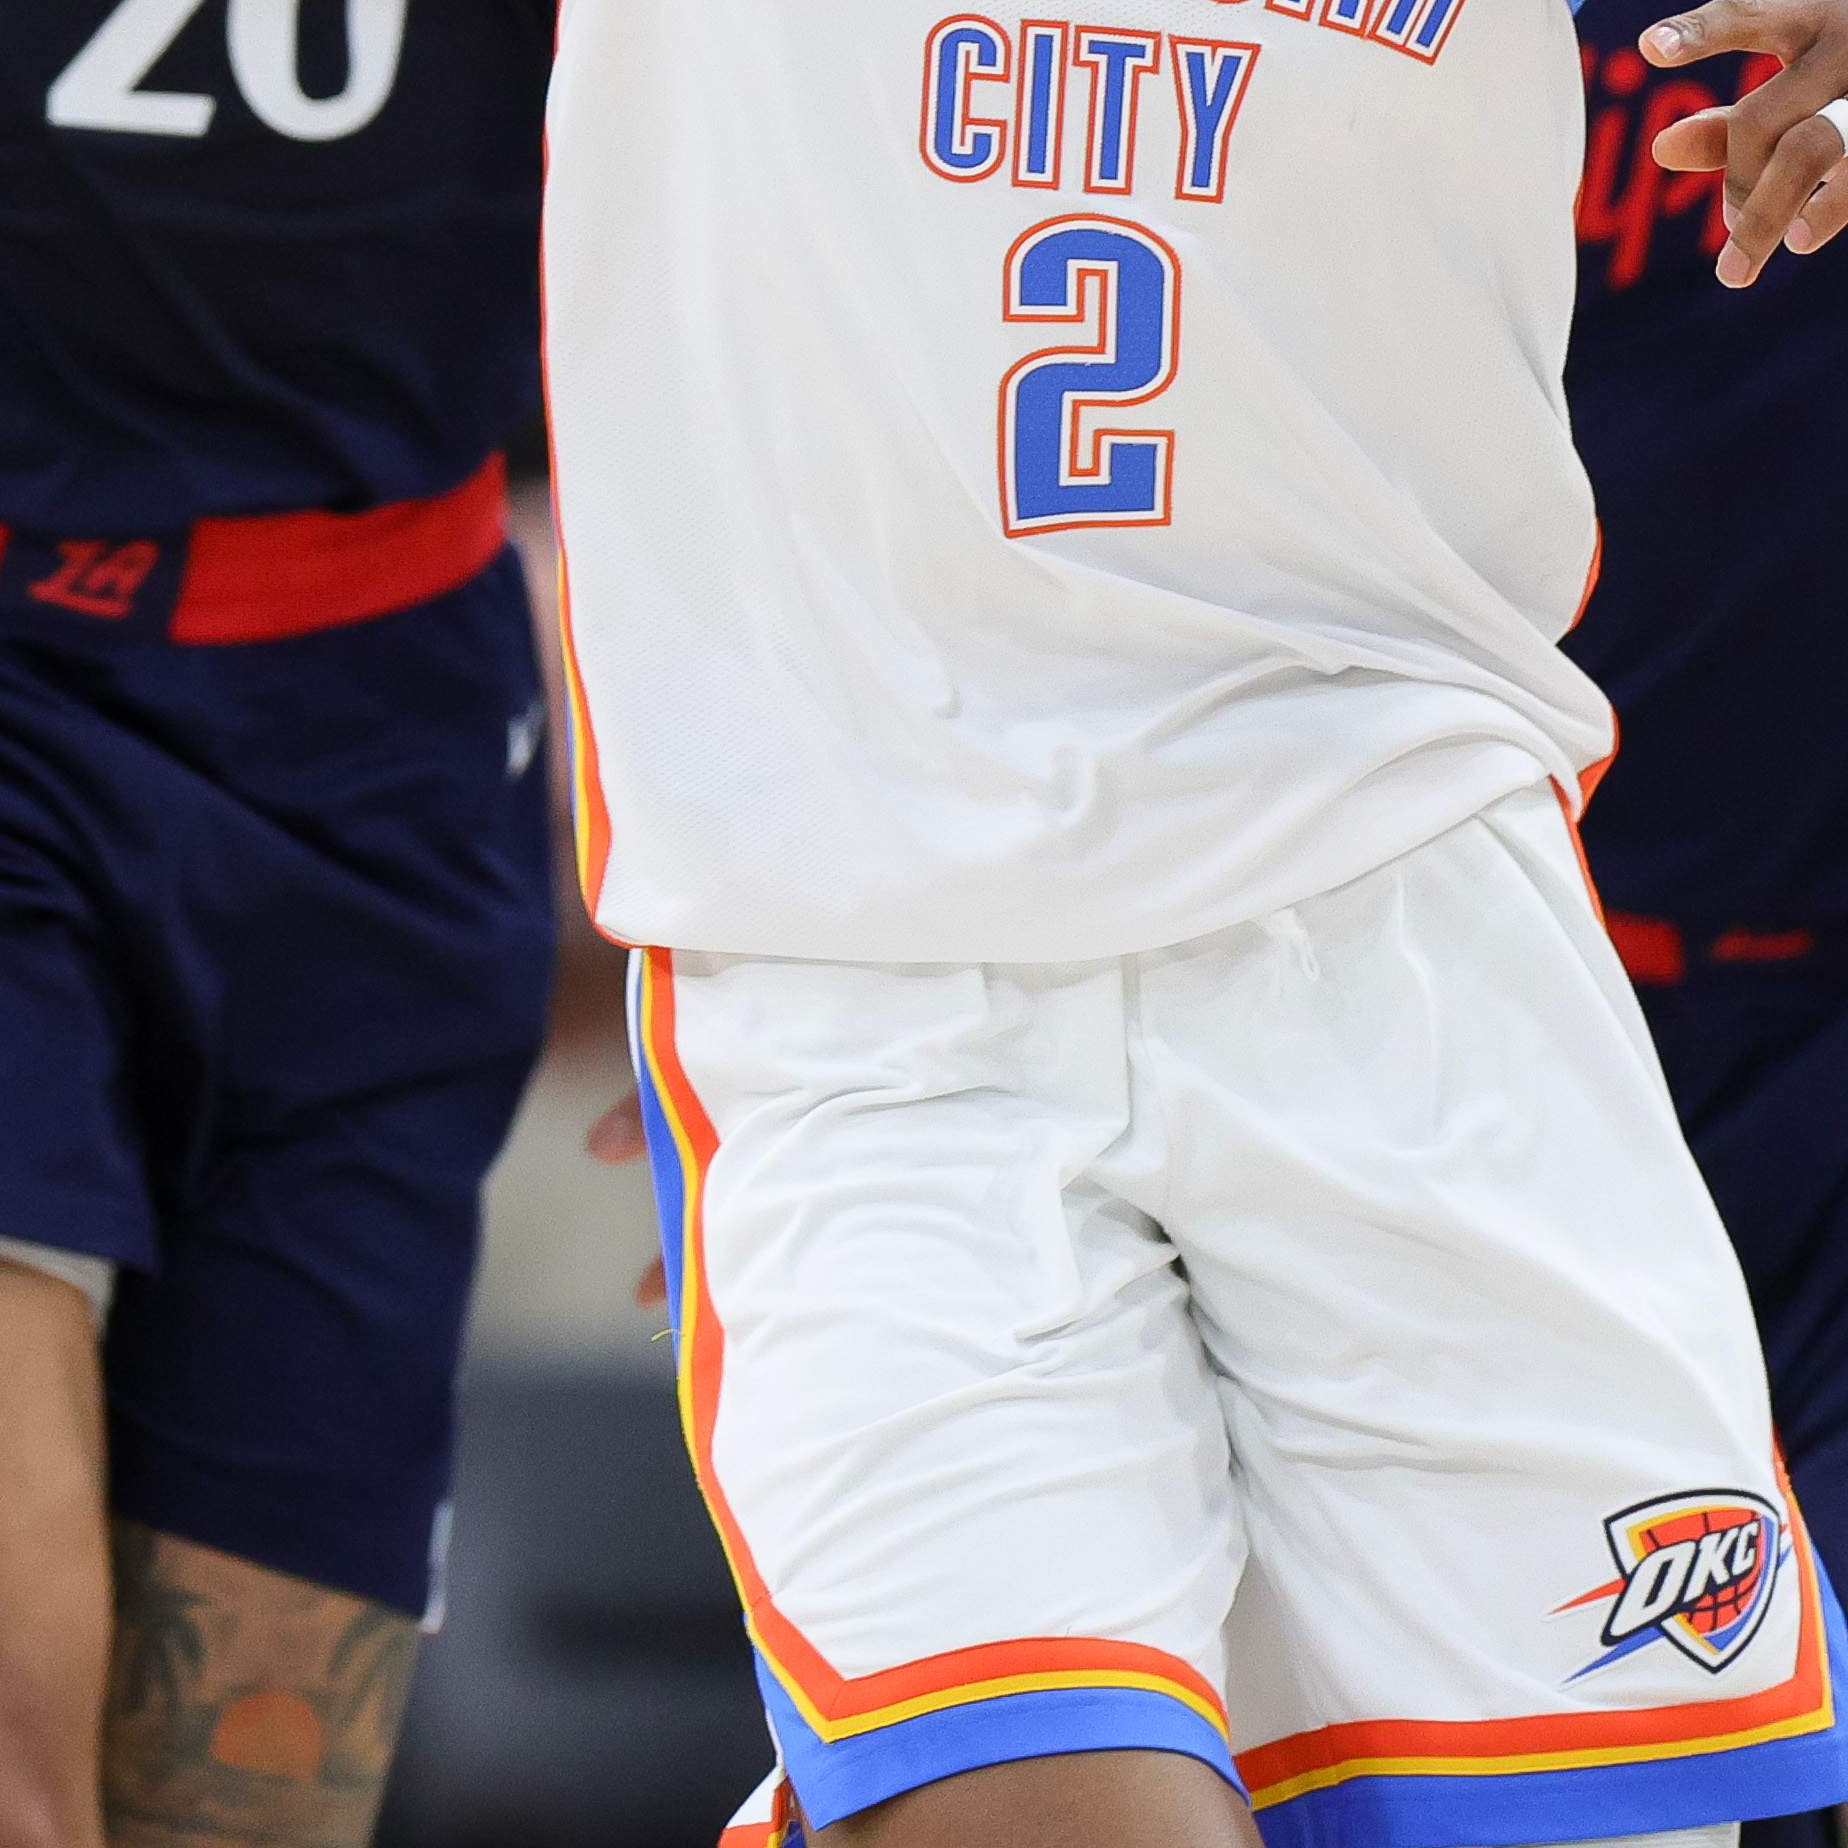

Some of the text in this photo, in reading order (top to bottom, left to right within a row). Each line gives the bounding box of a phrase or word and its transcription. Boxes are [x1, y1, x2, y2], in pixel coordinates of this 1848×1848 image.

[919, 12, 1262, 205] CITY
[997, 211, 1183, 540] 2
[1604, 1518, 1761, 1642] OKC
